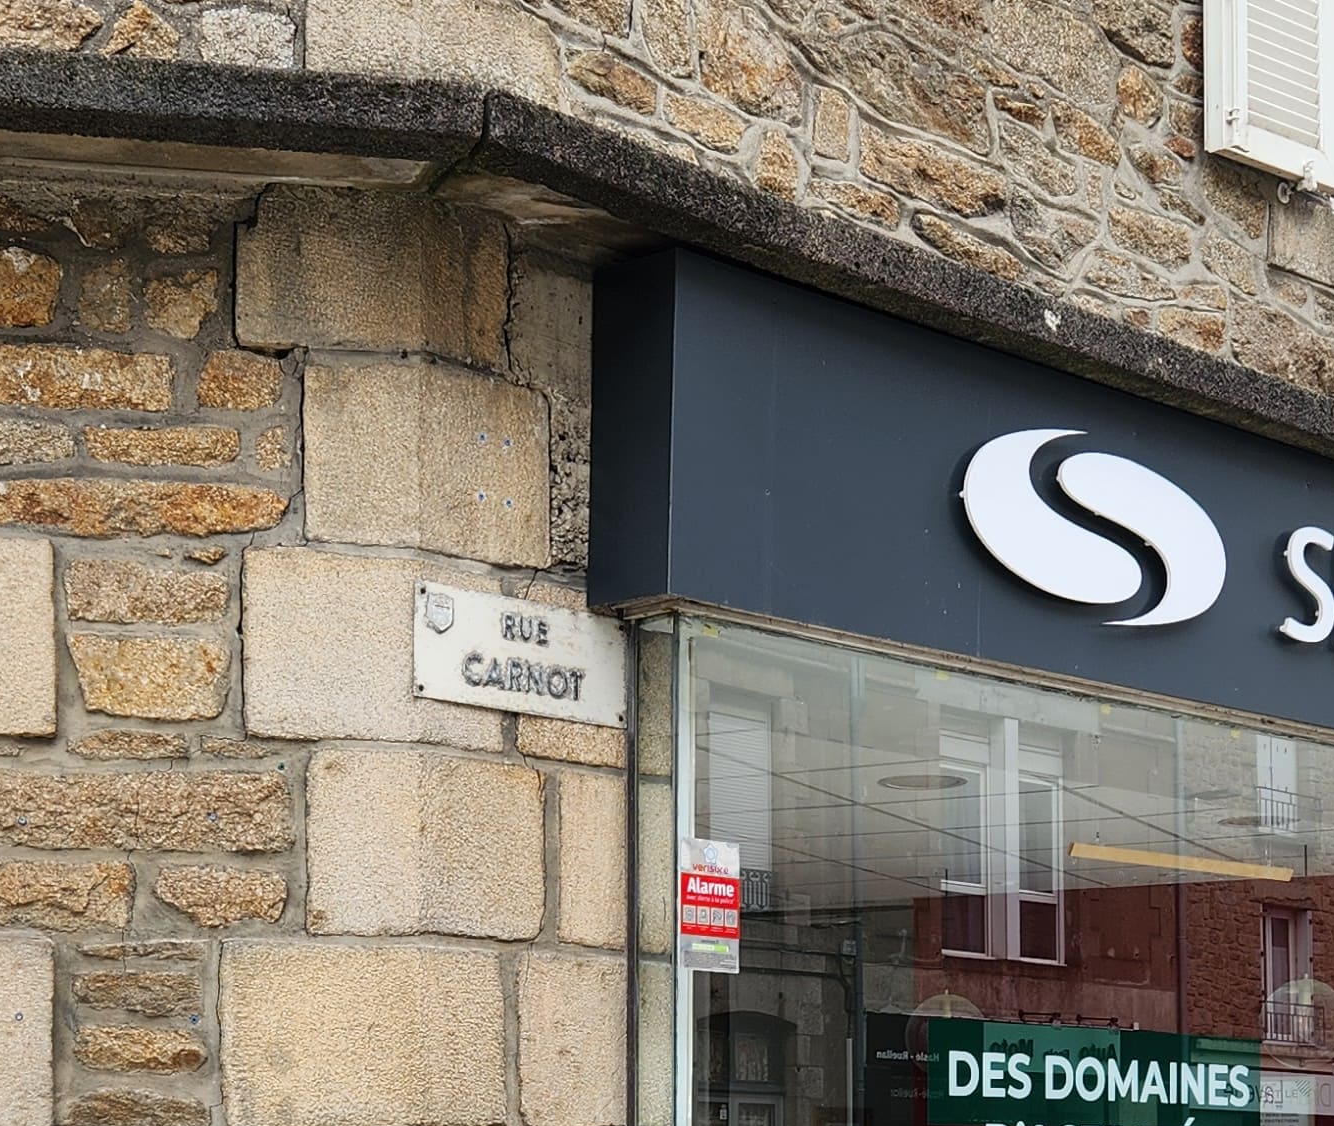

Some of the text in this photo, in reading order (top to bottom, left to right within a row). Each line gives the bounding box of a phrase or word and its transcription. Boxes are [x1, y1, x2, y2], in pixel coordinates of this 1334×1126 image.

[500, 611, 550, 647] RUE
[461, 651, 585, 701] CARNOT
[687, 877, 734, 897] Alarme
[948, 1050, 1251, 1107] DES DOMAINES
